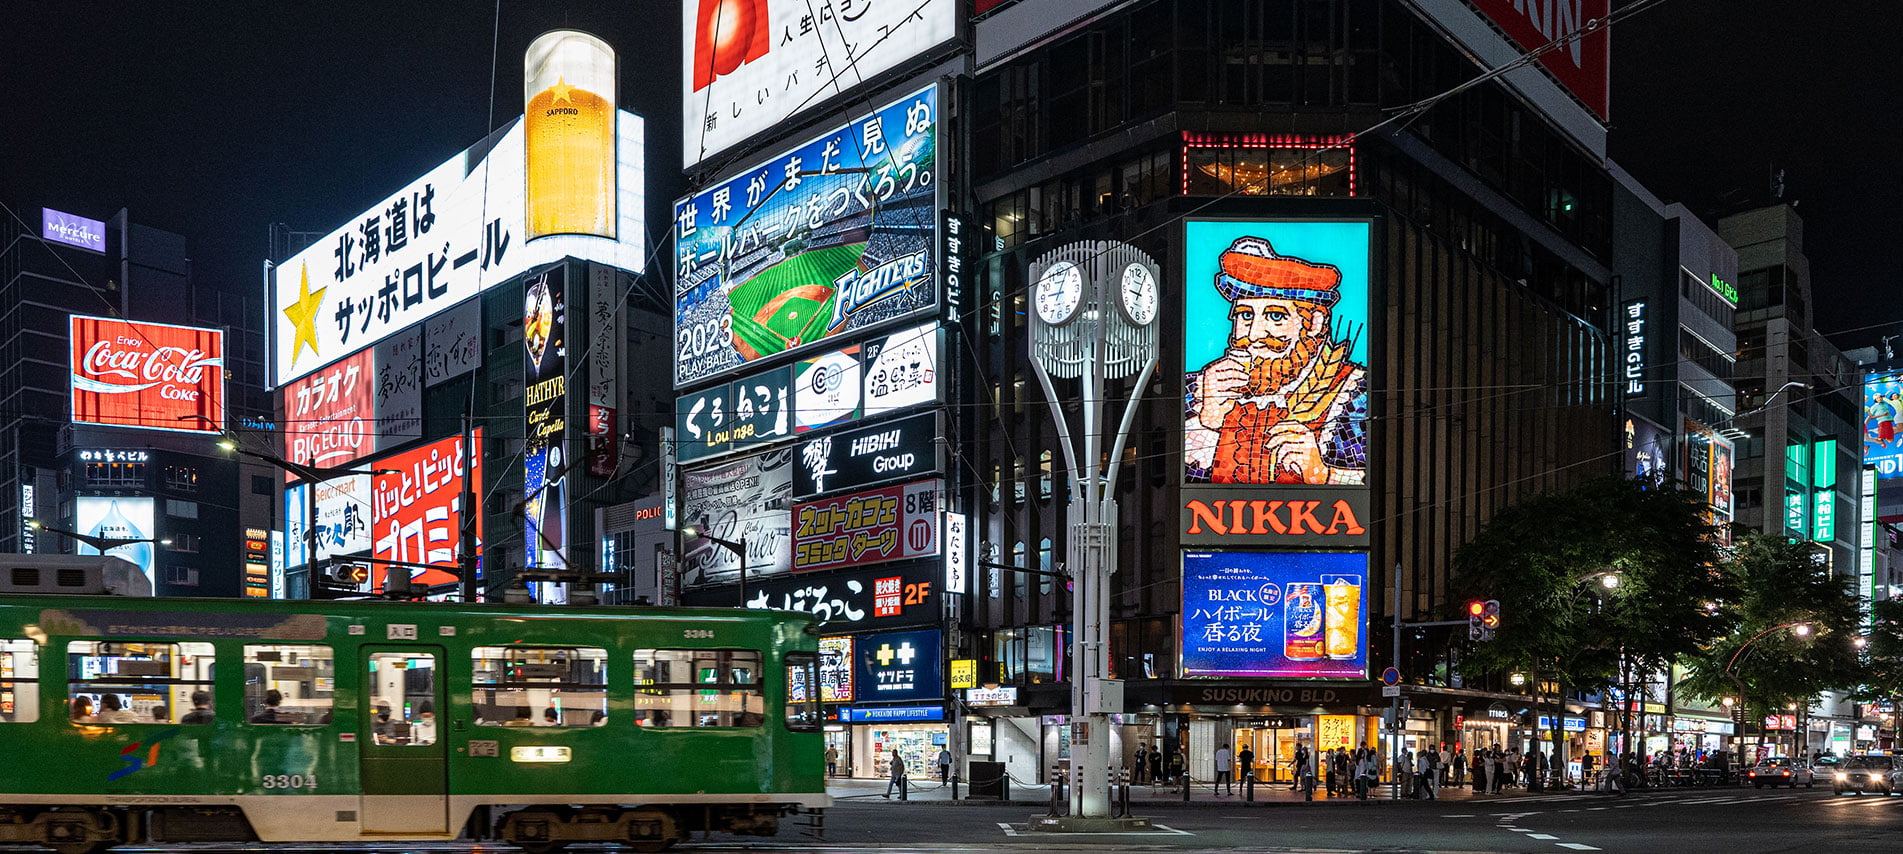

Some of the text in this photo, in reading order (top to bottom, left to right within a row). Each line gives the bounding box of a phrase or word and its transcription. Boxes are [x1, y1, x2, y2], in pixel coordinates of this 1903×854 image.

[546, 106, 578, 116] SAPPORO
[678, 100, 932, 239] 世界がまだ見ぬ
[679, 156, 931, 279] ボールパークをつくろう。
[47, 222, 101, 242] Mercure
[334, 184, 436, 283] 北海道は
[334, 217, 511, 345] サッポロビール
[826, 250, 928, 332] FIGHTERS
[116, 335, 142, 347] Enjoy
[679, 314, 733, 361] 2023
[83, 340, 205, 384] Coca-Cola
[679, 350, 732, 377] PLAY BALL
[867, 344, 880, 360] 2F
[160, 384, 199, 402] Coke
[296, 365, 360, 416] カラオケ
[526, 375, 566, 407] HATHYR
[293, 428, 320, 466] BIG
[322, 416, 364, 450] ECHO
[706, 424, 754, 448] Lounge
[850, 429, 901, 457] HIBIKI
[873, 453, 914, 473] Group
[1690, 472, 1708, 494] CLUB
[906, 491, 935, 516] 8階
[797, 496, 898, 538] ネットカフェ
[1185, 499, 1366, 536] NIKKA
[796, 537, 848, 568] コミック
[853, 528, 899, 561] ダーツ
[904, 582, 930, 606] 2F
[1208, 589, 1257, 601] BLACK
[1191, 605, 1274, 621] ハイボール
[390, 626, 415, 638] 入口
[1201, 622, 1262, 642] 香る夜
[1202, 688, 1340, 703] SUSUKINO BLD.
[907, 709, 928, 718] LIFESTYLE
[263, 773, 318, 790] 3304
